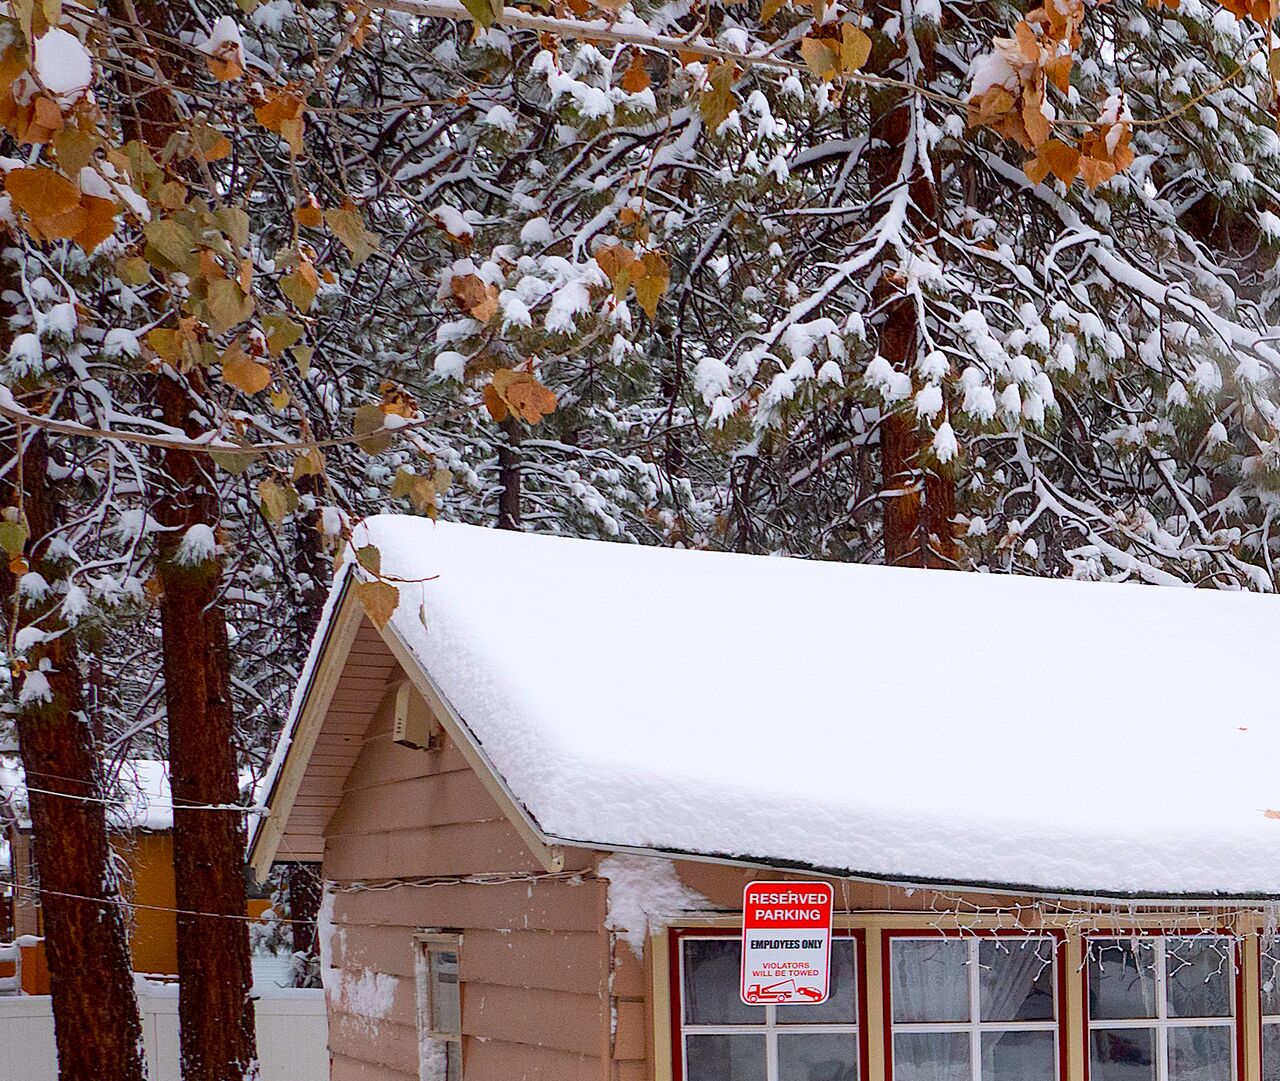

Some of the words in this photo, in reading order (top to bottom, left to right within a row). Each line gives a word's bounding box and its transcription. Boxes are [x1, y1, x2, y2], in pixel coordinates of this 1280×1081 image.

[749, 893, 828, 905] RESERVED
[755, 909, 821, 920] PARKING
[750, 939, 800, 950] EMPLOYEES
[801, 939, 824, 950] ONLY
[789, 969, 819, 977] TOWED
